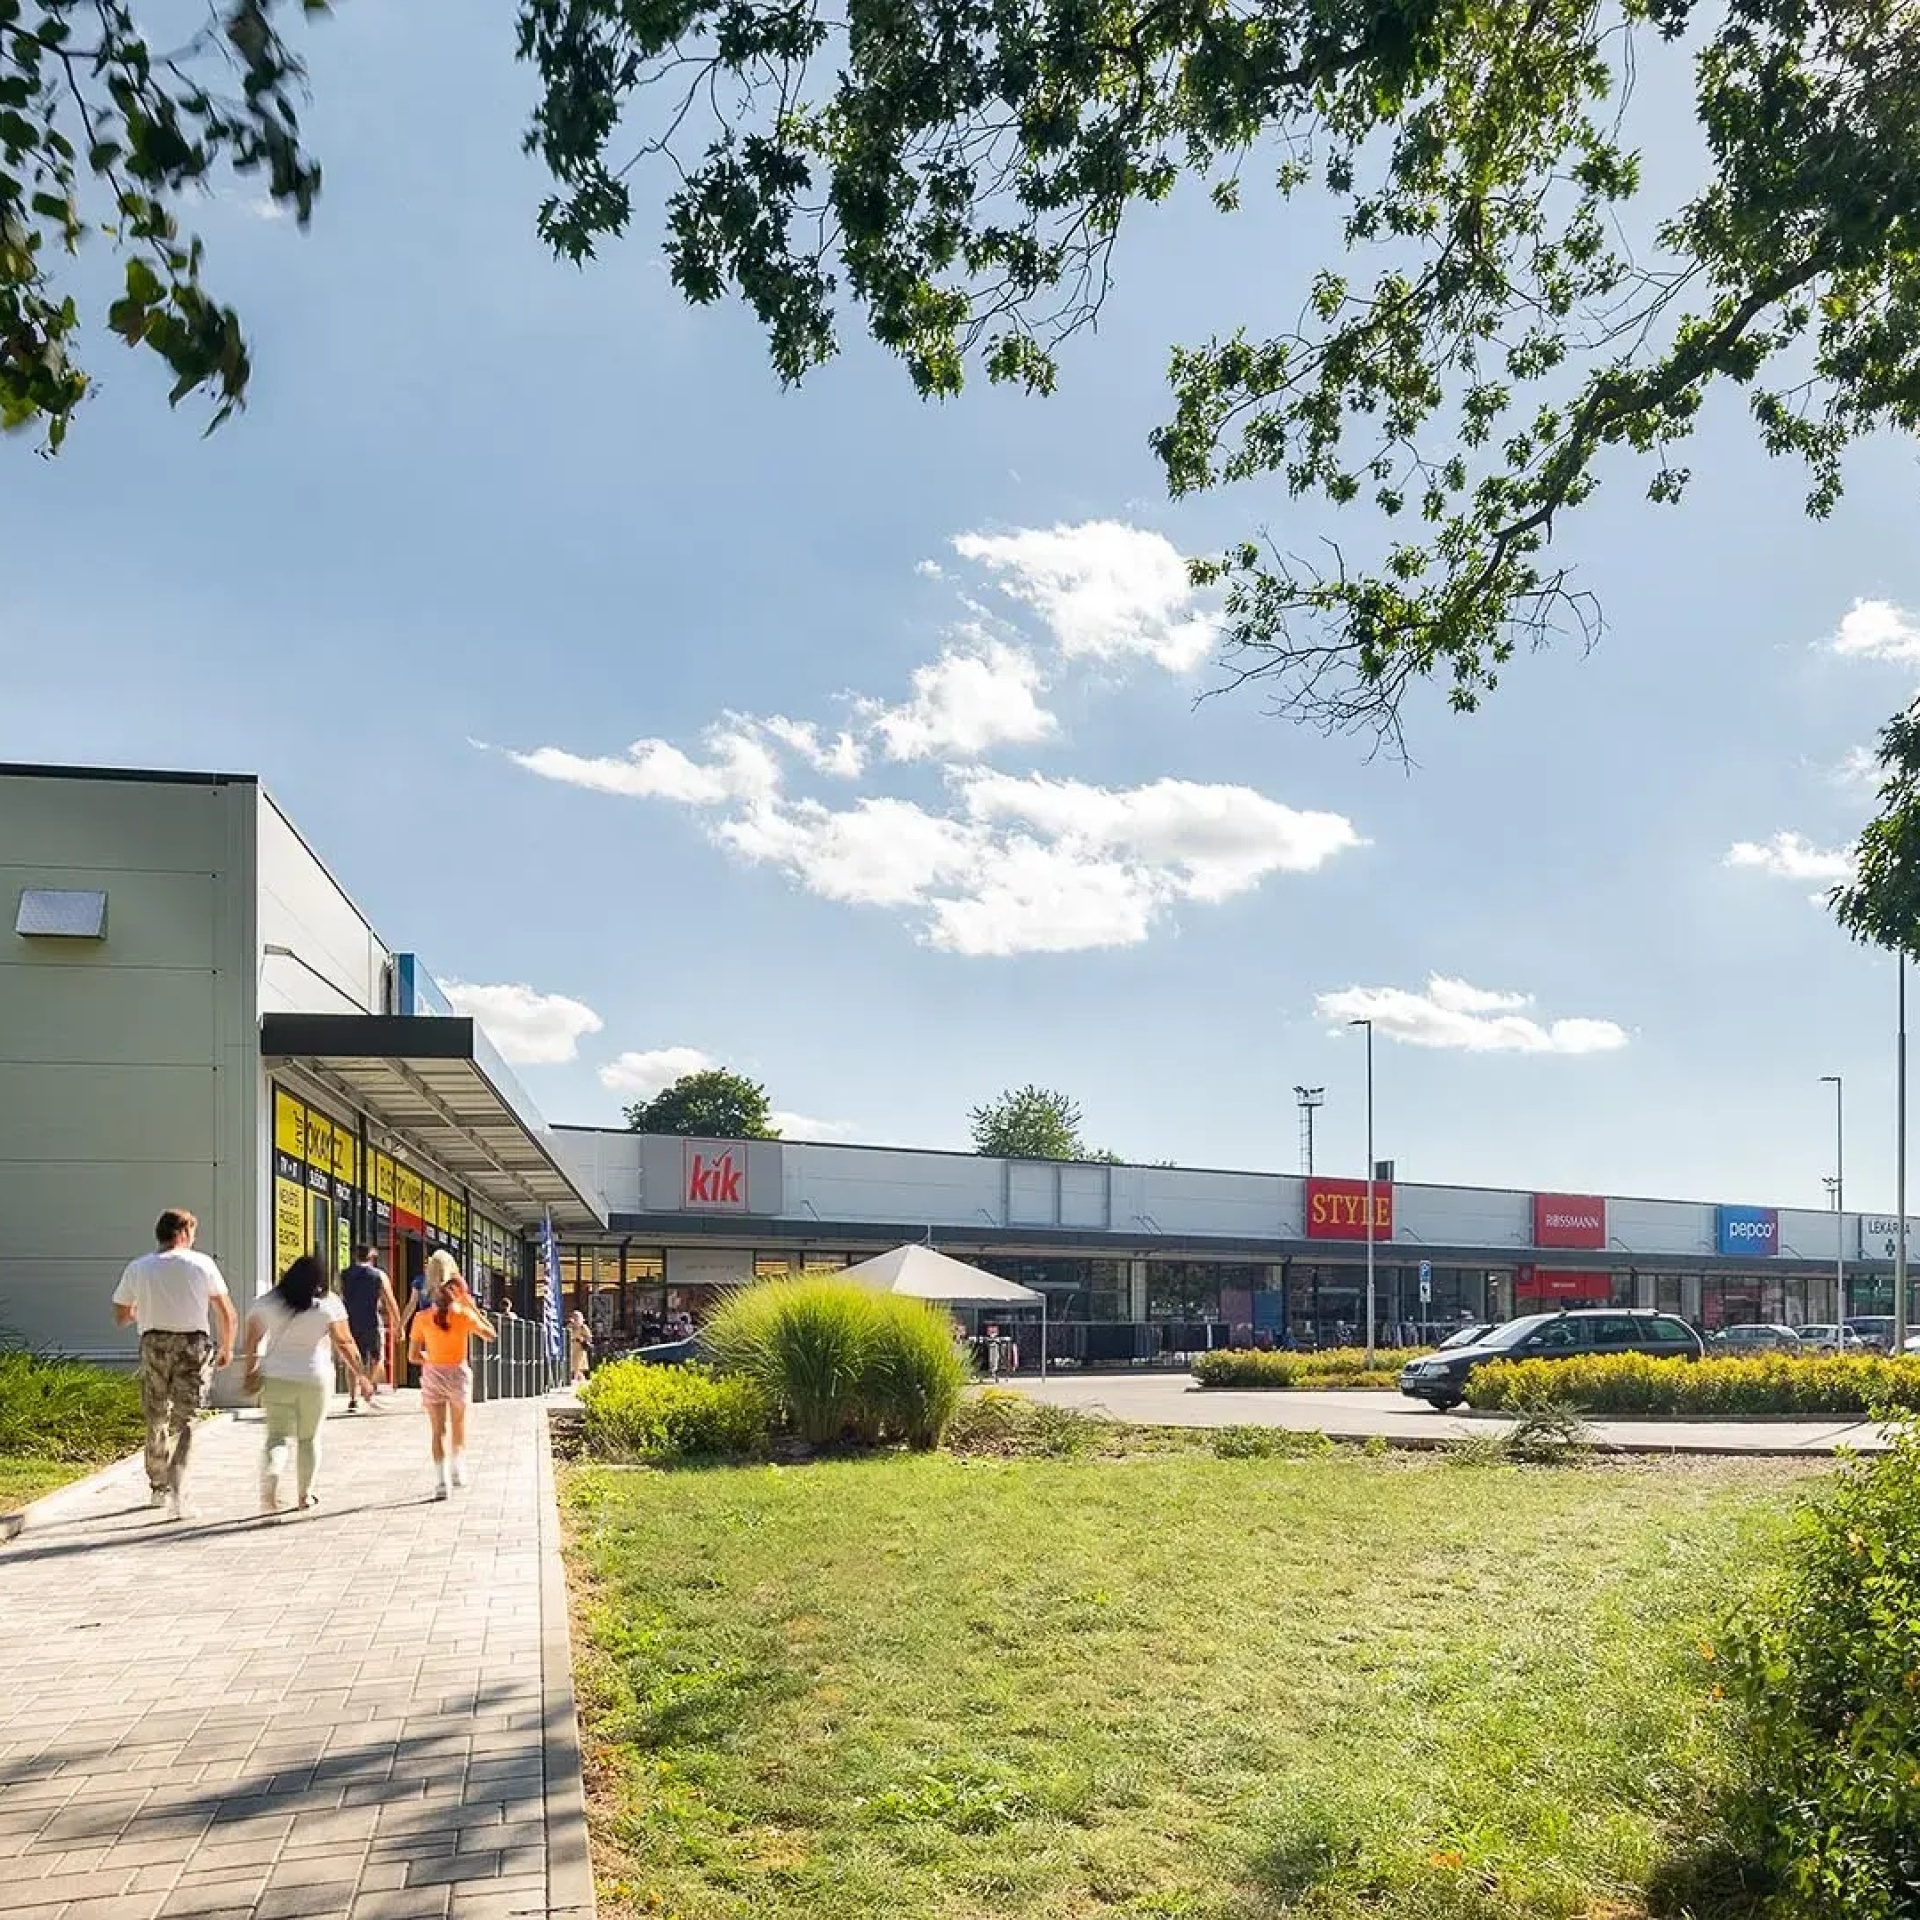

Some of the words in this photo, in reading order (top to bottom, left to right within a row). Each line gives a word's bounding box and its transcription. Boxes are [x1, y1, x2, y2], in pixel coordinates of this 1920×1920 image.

[1311, 1194, 1391, 1227] STYLE
[1545, 1213, 1600, 1229] ROSSMANN
[1730, 1222, 1771, 1242] pepco
